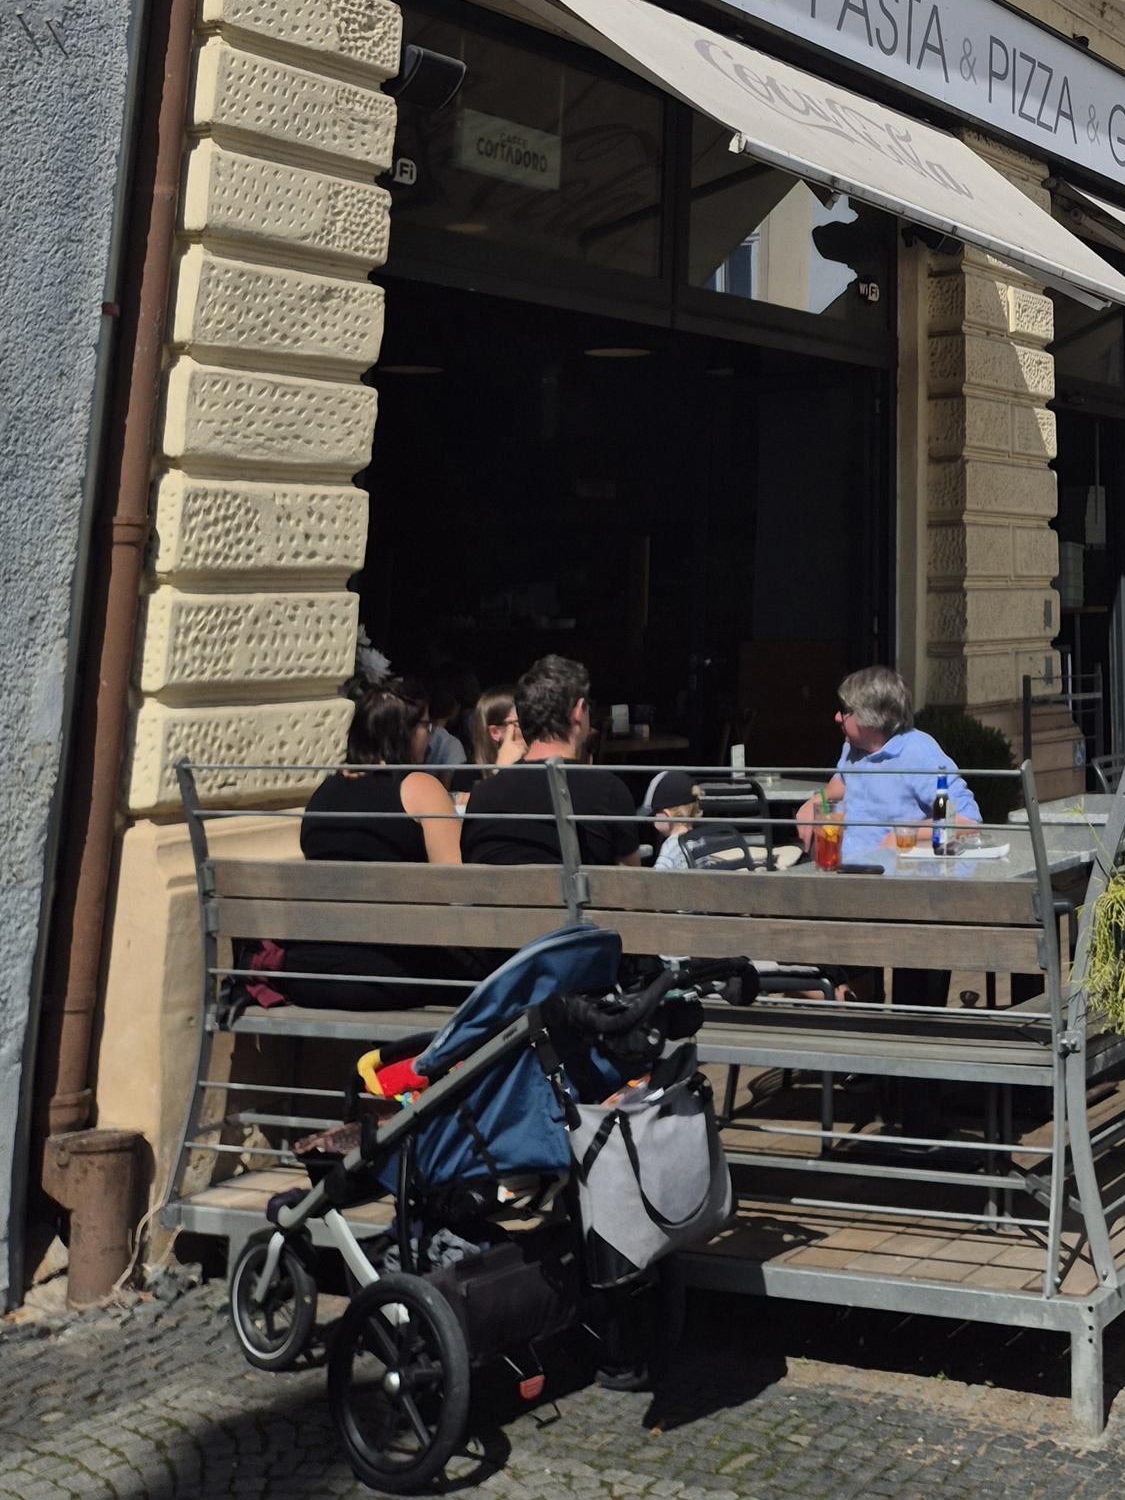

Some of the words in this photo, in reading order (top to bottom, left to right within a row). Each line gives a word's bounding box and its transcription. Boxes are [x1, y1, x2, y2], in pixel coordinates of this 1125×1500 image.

[959, 37, 978, 85] &
[987, 36, 1078, 145] PIZZA
[1086, 104, 1101, 147] &
